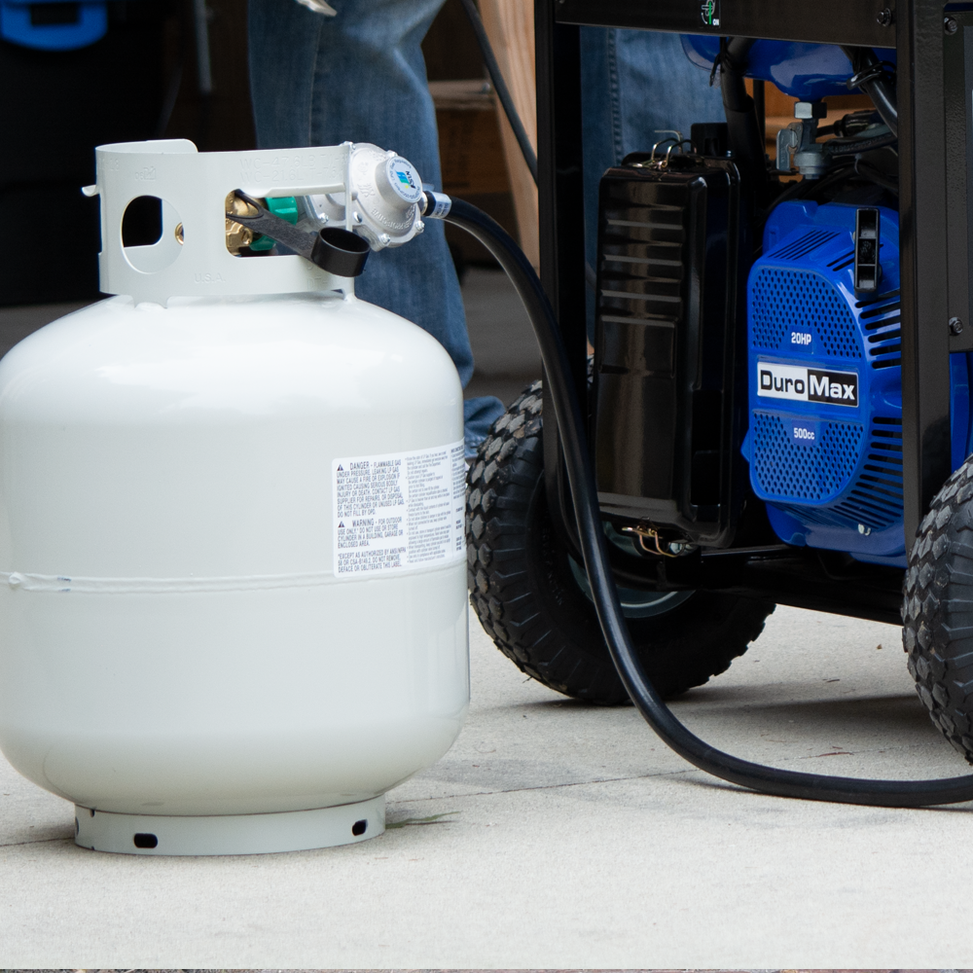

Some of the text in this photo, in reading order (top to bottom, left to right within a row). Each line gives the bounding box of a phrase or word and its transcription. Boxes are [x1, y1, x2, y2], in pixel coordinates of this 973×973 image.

[791, 332, 812, 345] 20HP
[793, 428, 815, 440] 500cc
[350, 461, 369, 470] DANGER
[352, 518, 374, 527] WARNING
